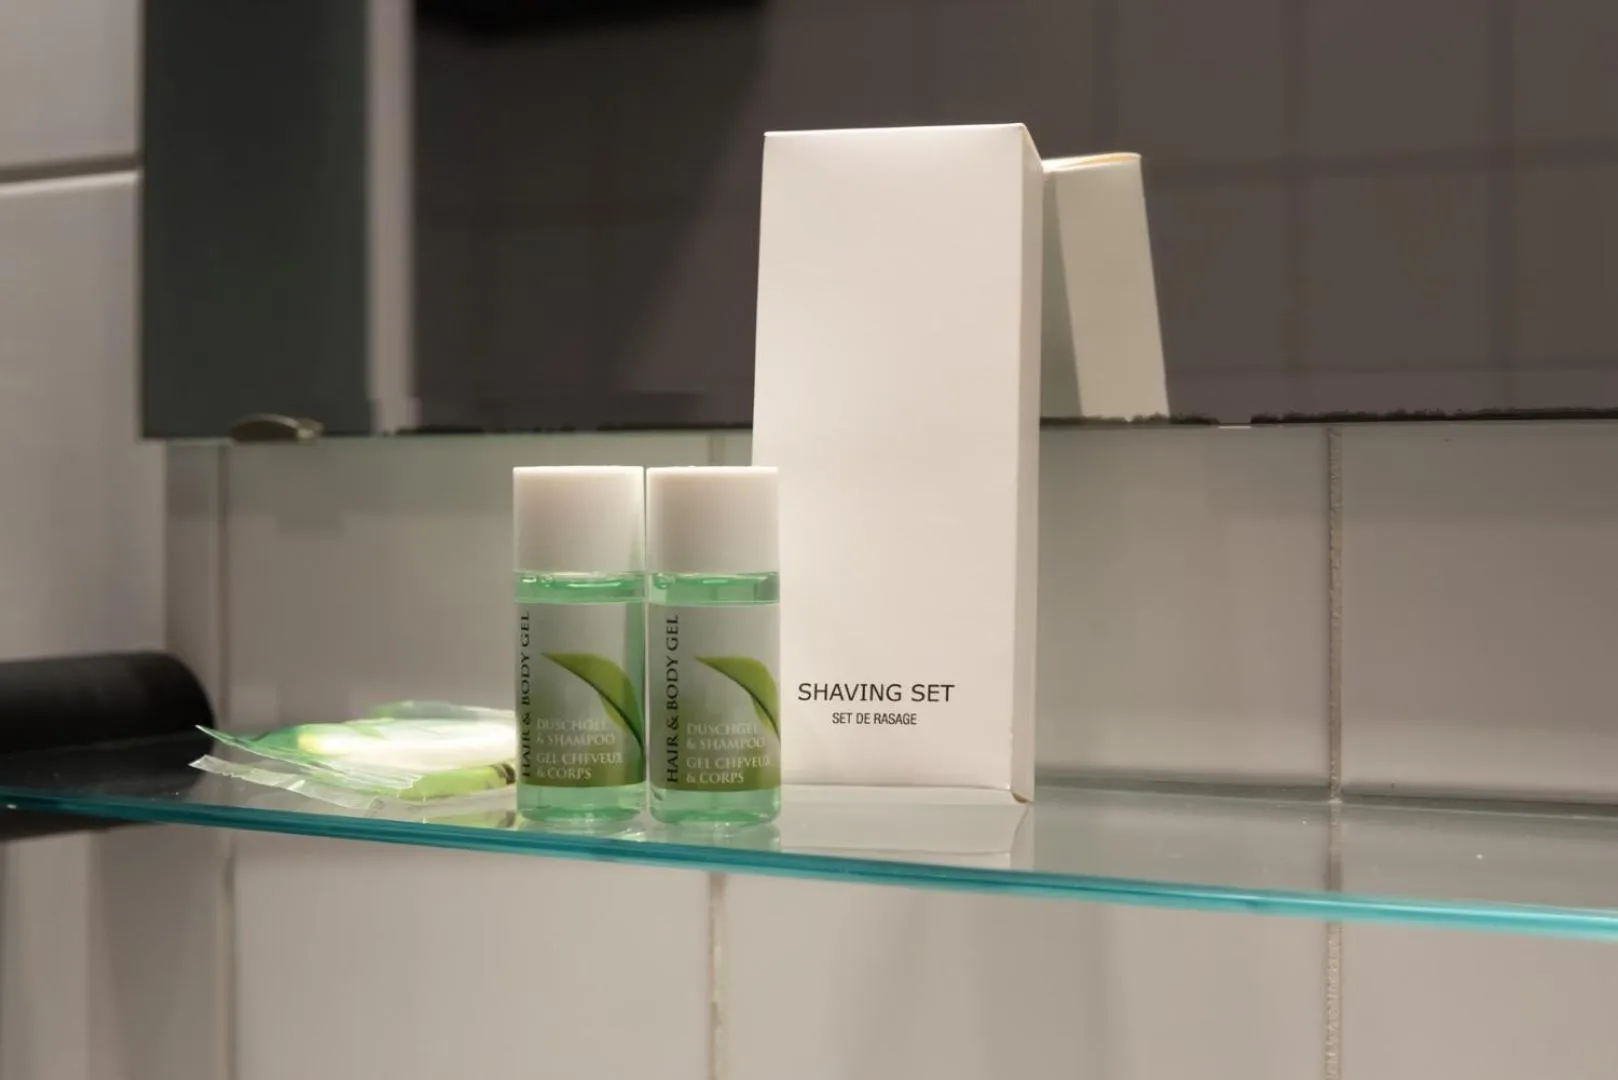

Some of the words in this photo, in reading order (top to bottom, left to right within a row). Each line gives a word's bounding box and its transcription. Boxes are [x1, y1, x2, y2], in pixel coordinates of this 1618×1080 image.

[520, 611, 530, 648] GEL
[666, 614, 679, 651] GEL
[520, 652, 531, 706] BODY
[666, 655, 679, 710] BODY
[798, 683, 902, 702] SHAVING
[911, 684, 955, 702] SET
[521, 711, 531, 726] &
[536, 718, 608, 731] DUSCHGEL
[666, 715, 679, 731] &
[832, 712, 852, 724] SET
[856, 713, 871, 724] DE
[874, 713, 917, 725] RASAGE
[686, 722, 759, 735] DUSCHGEL
[547, 732, 616, 746] SHAMPOO
[700, 737, 766, 750] SHAMPOO
[521, 731, 531, 777] HAIR
[536, 752, 557, 765] GEL
[561, 752, 624, 765] CHEVEUX
[666, 735, 679, 783] HAIR
[686, 757, 710, 769] GEL
[547, 767, 592, 779] CORPS
[699, 772, 745, 784] CORPS
